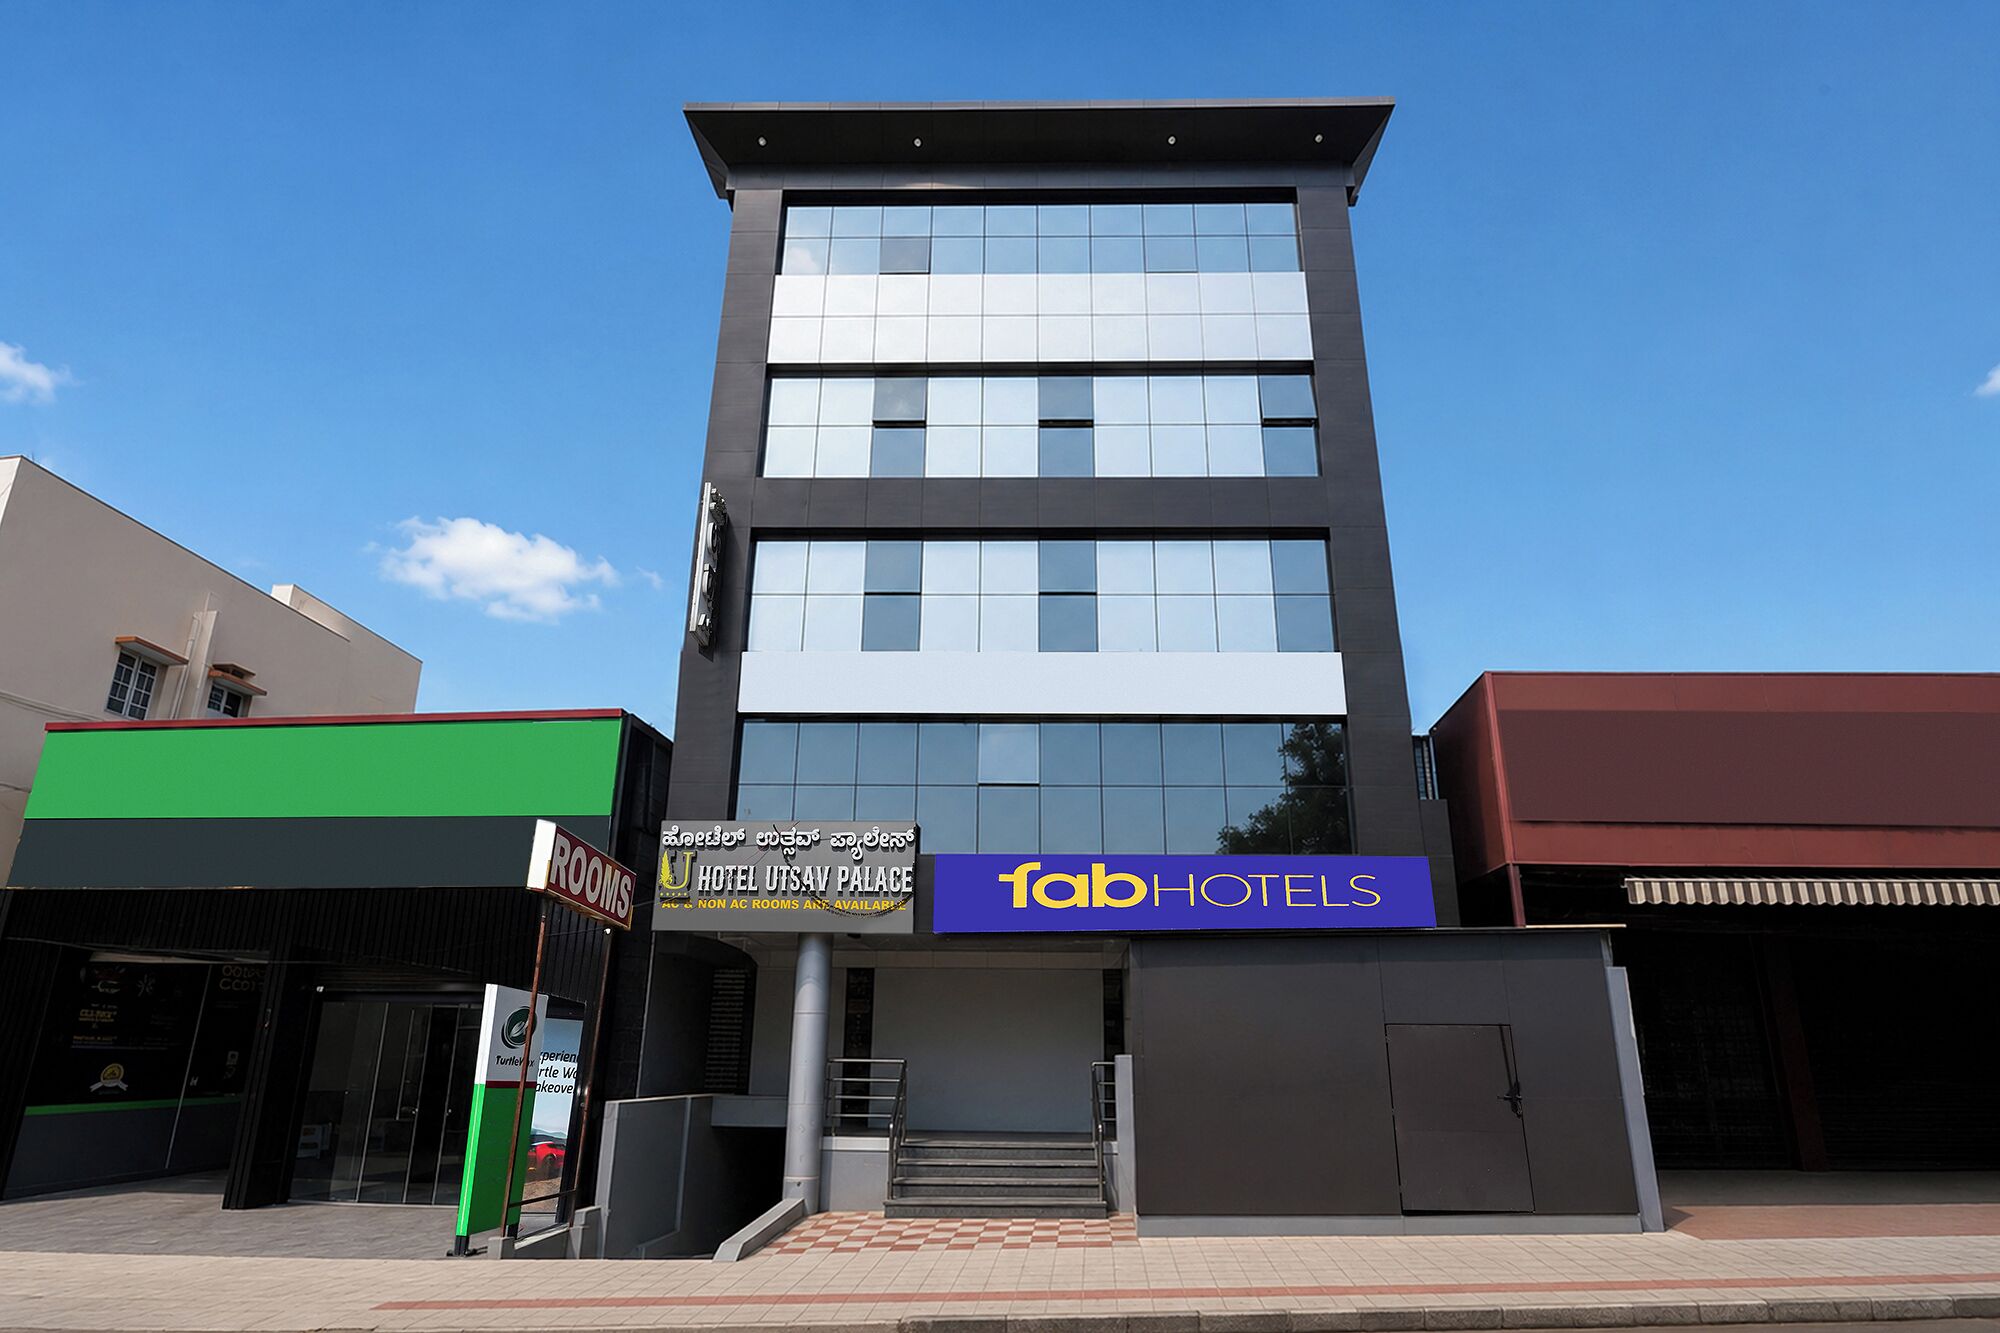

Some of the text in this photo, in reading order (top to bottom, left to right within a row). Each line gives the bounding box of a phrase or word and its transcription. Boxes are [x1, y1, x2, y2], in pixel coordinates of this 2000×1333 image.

[662, 825, 746, 847] ಹೋಟೆಲ್
[549, 833, 632, 919] ROOMS
[698, 865, 914, 893] HOTEL UTSAV PALACE
[698, 899, 727, 909] NON
[730, 899, 748, 909] AC
[751, 899, 800, 910] ROOMS
